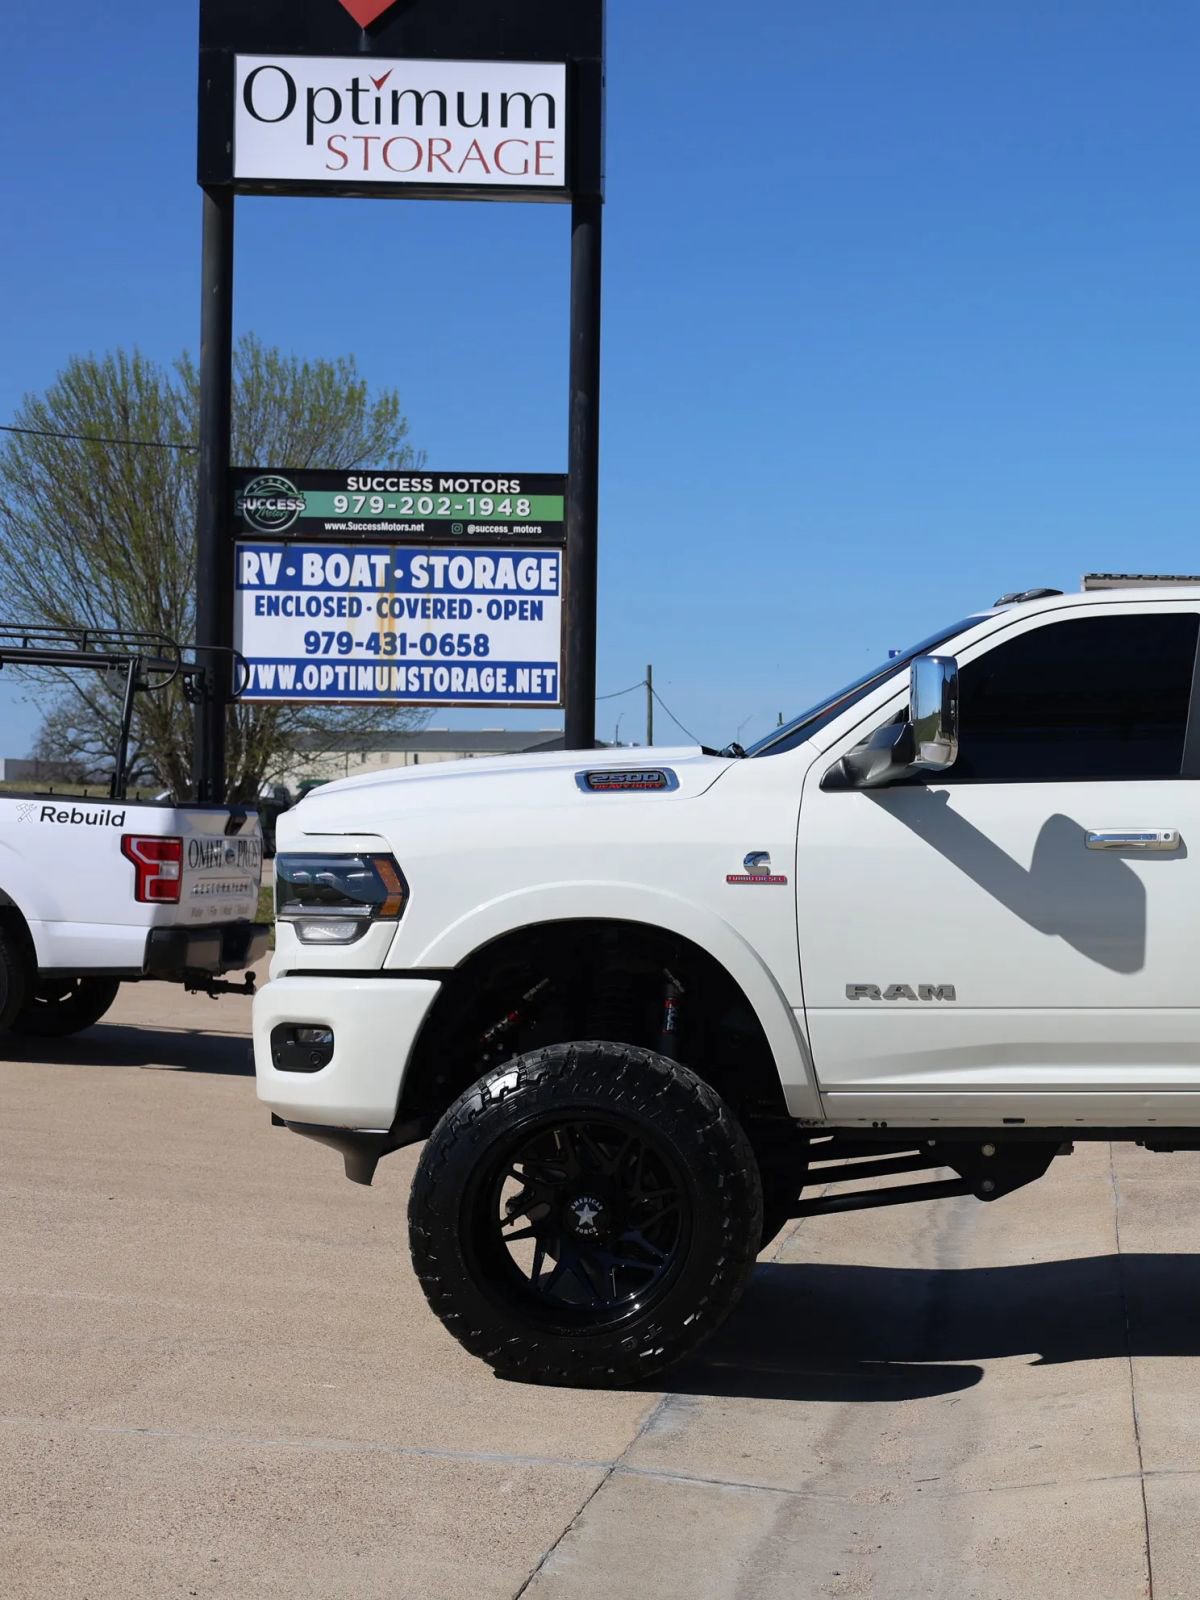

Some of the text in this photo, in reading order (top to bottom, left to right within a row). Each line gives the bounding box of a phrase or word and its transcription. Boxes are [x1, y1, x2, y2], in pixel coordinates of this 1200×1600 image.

[243, 65, 556, 145] Optimum
[325, 134, 556, 176] STORAGE
[347, 477, 521, 493] SUCCESS MOTORS
[237, 498, 305, 511] SUCCESS
[333, 495, 531, 516] 979-202-1948
[324, 522, 424, 532] www.SuccessMotors.net
[467, 524, 542, 534] @success_motors
[239, 552, 557, 590] RV BOAT STORAGE
[254, 595, 543, 621] ENCLOSED COVERED OPEN
[303, 630, 490, 657] 979-431-0658
[236, 663, 556, 694] WWW.OPTIMUMSTORAGE.NET
[591, 772, 660, 783] 2500
[40, 806, 126, 827] Rebuild
[845, 983, 957, 1001] RAM
